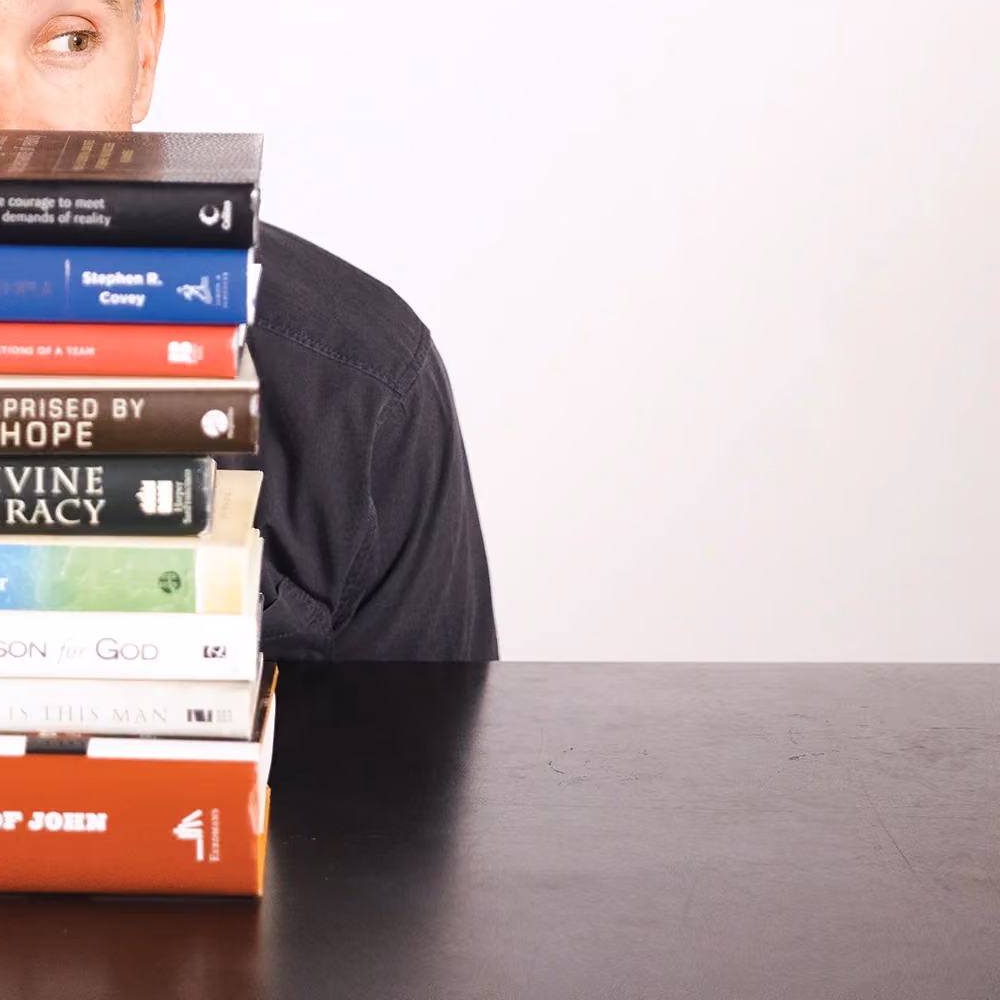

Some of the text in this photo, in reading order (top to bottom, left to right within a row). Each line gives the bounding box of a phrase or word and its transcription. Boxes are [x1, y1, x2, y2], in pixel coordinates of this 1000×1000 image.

[8, 196, 55, 210] courage
[58, 197, 72, 208] to
[74, 197, 105, 209] meet
[1, 212, 54, 224] demands
[58, 212, 71, 224] of
[73, 213, 111, 228] reality
[81, 270, 163, 287] Stephen R.
[98, 290, 146, 307] Covey
[37, 346, 52, 356] OF
[55, 346, 64, 356] A
[67, 346, 95, 356] TEAM
[111, 398, 145, 419] BY
[0, 421, 93, 448] HOPE
[95, 638, 159, 661] GOD
[9, 703, 30, 720] IS
[44, 703, 100, 721] THIS
[112, 707, 169, 723] MAN
[28, 811, 108, 832] JOHN
